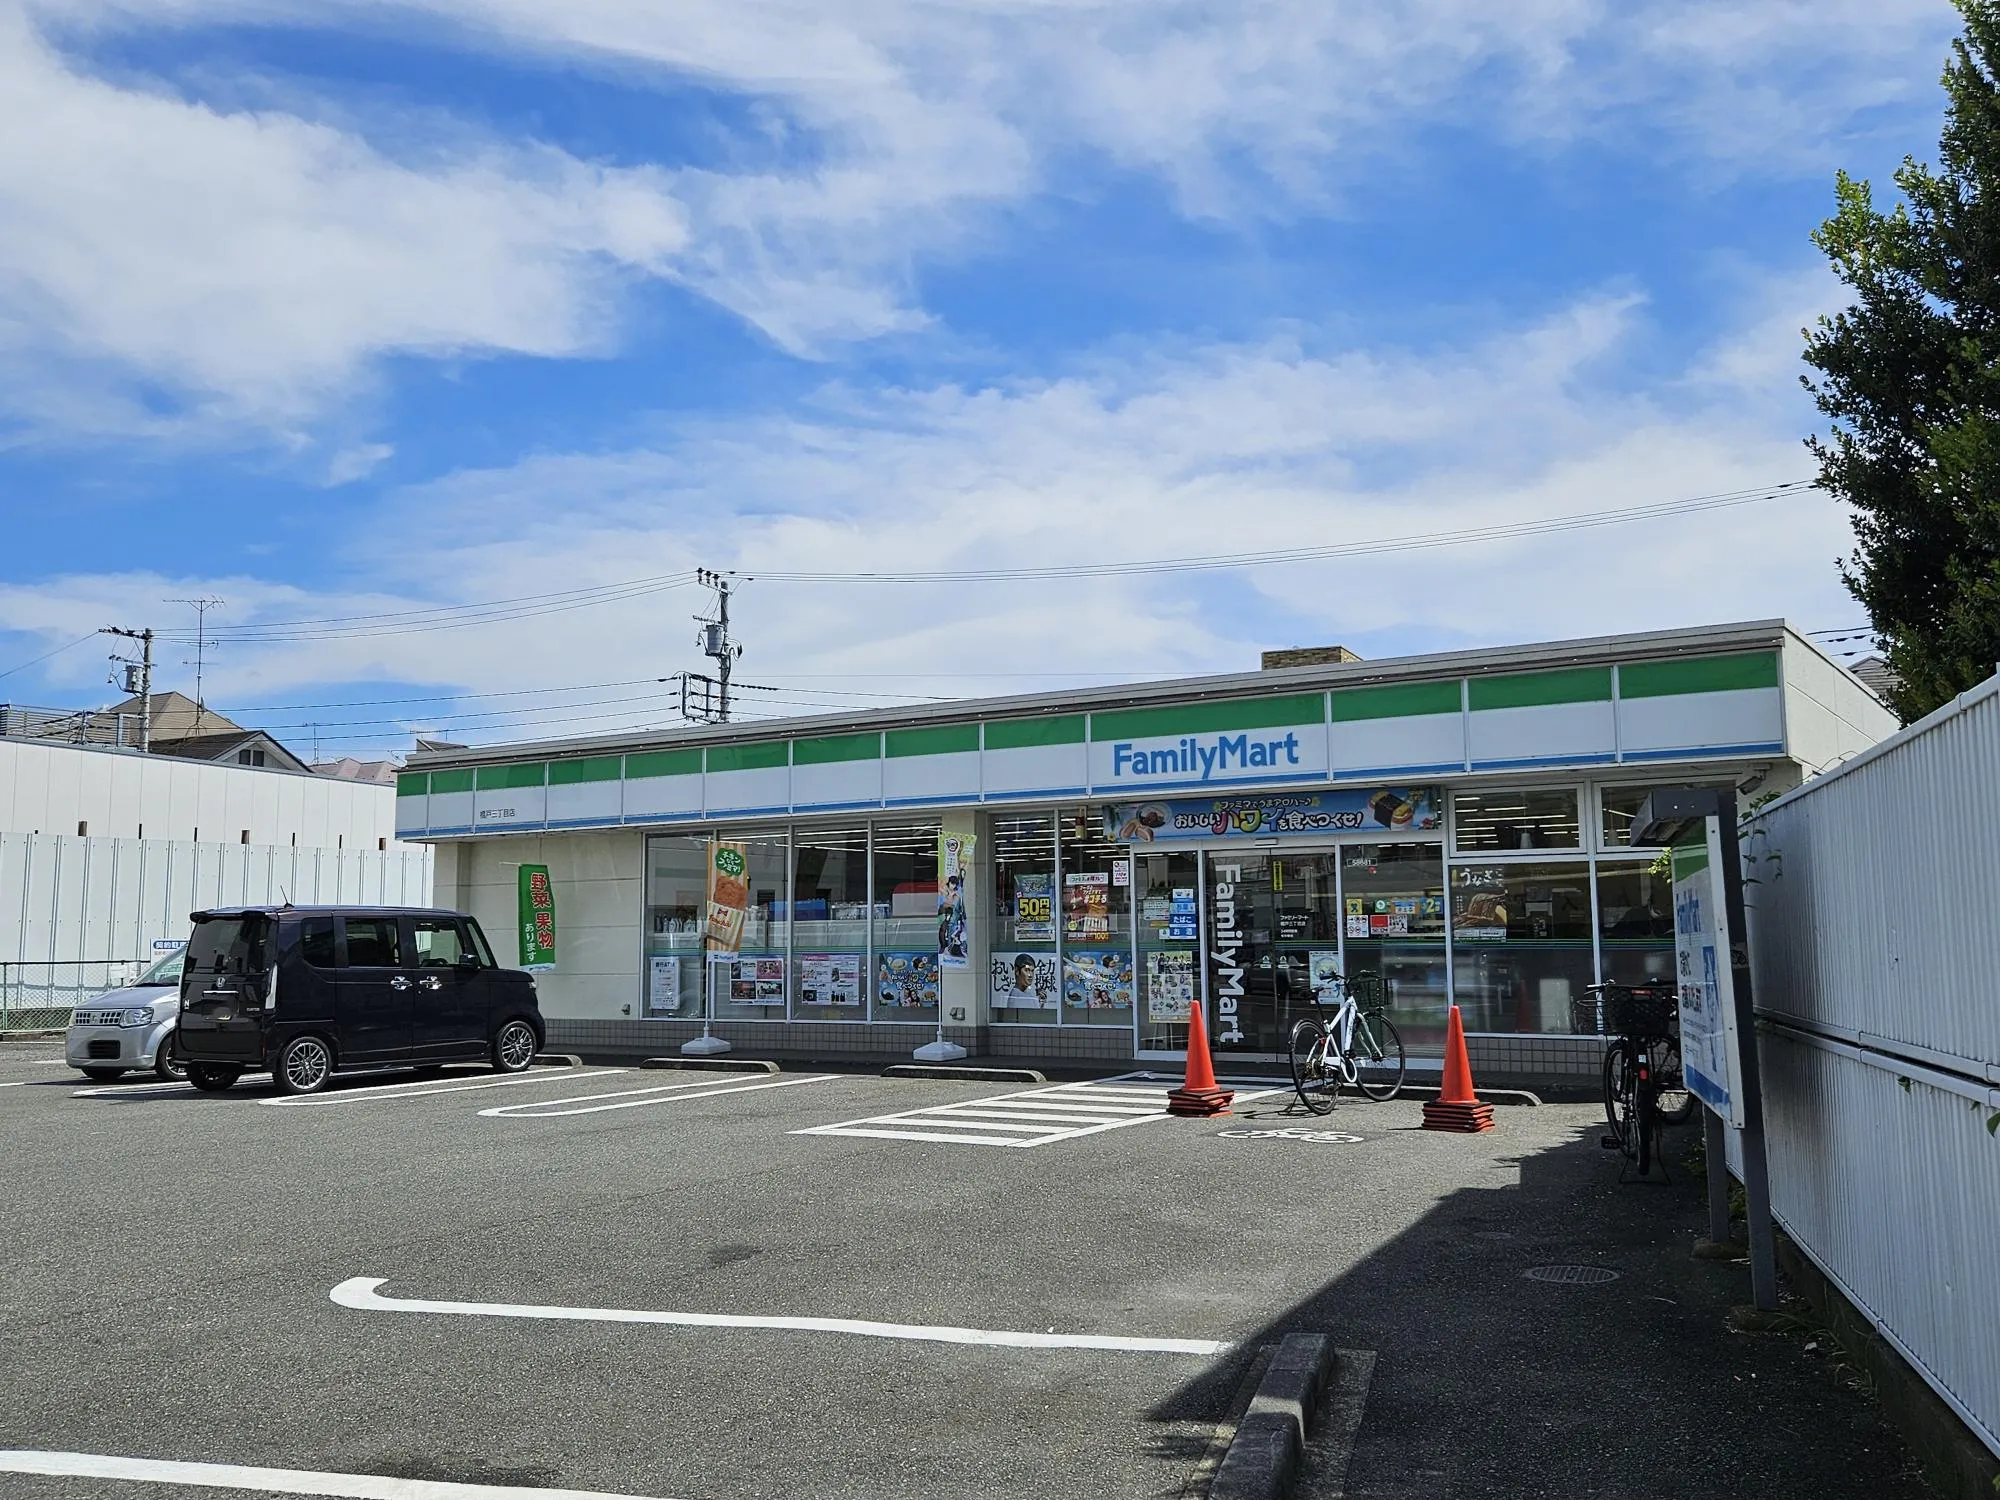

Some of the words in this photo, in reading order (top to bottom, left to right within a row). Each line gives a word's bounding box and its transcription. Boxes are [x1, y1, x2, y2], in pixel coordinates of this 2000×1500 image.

[1113, 732, 1299, 780] FamilyMart
[530, 872, 552, 908] 野菜
[535, 912, 555, 949] 果物
[1173, 915, 1193, 924] たばこ
[525, 923, 537, 962] あります
[1210, 864, 1245, 1043] FamilyMart
[991, 958, 1014, 975] おい
[1036, 959, 1056, 975] 全力
